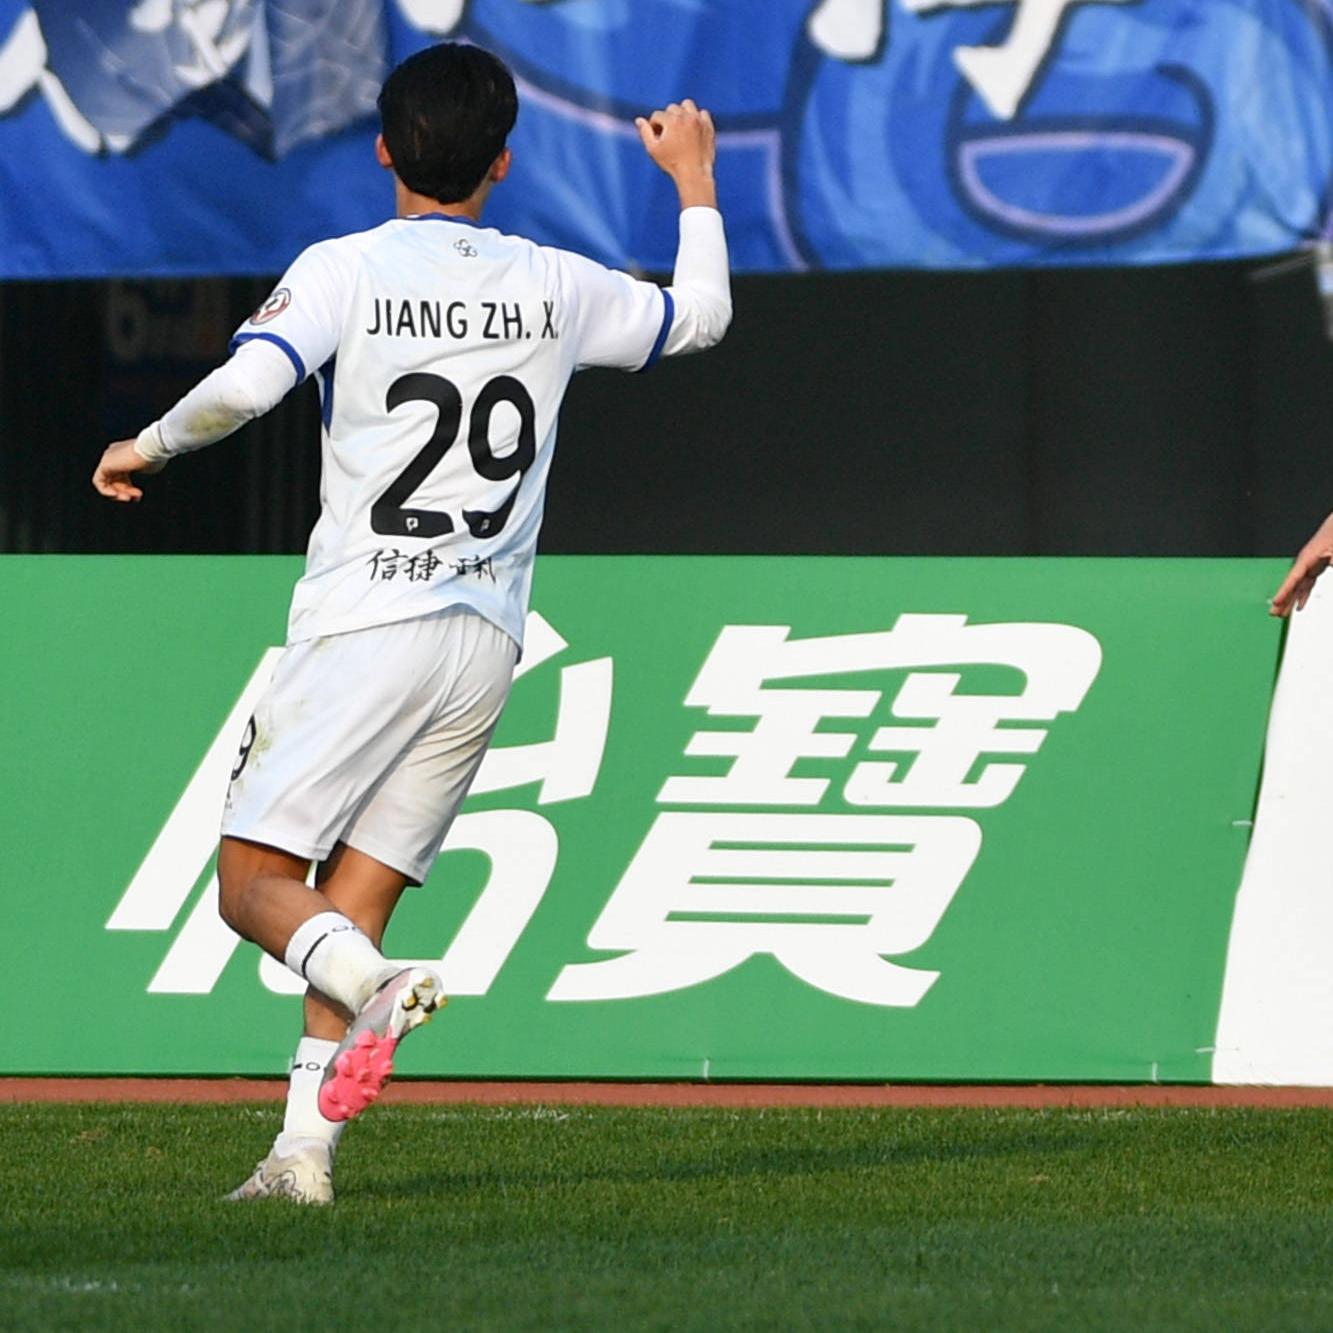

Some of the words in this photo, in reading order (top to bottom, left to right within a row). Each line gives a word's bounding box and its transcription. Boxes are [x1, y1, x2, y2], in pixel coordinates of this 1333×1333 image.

[366, 299, 468, 340] JIANG
[482, 301, 532, 341] ZH.
[370, 372, 536, 540] 29
